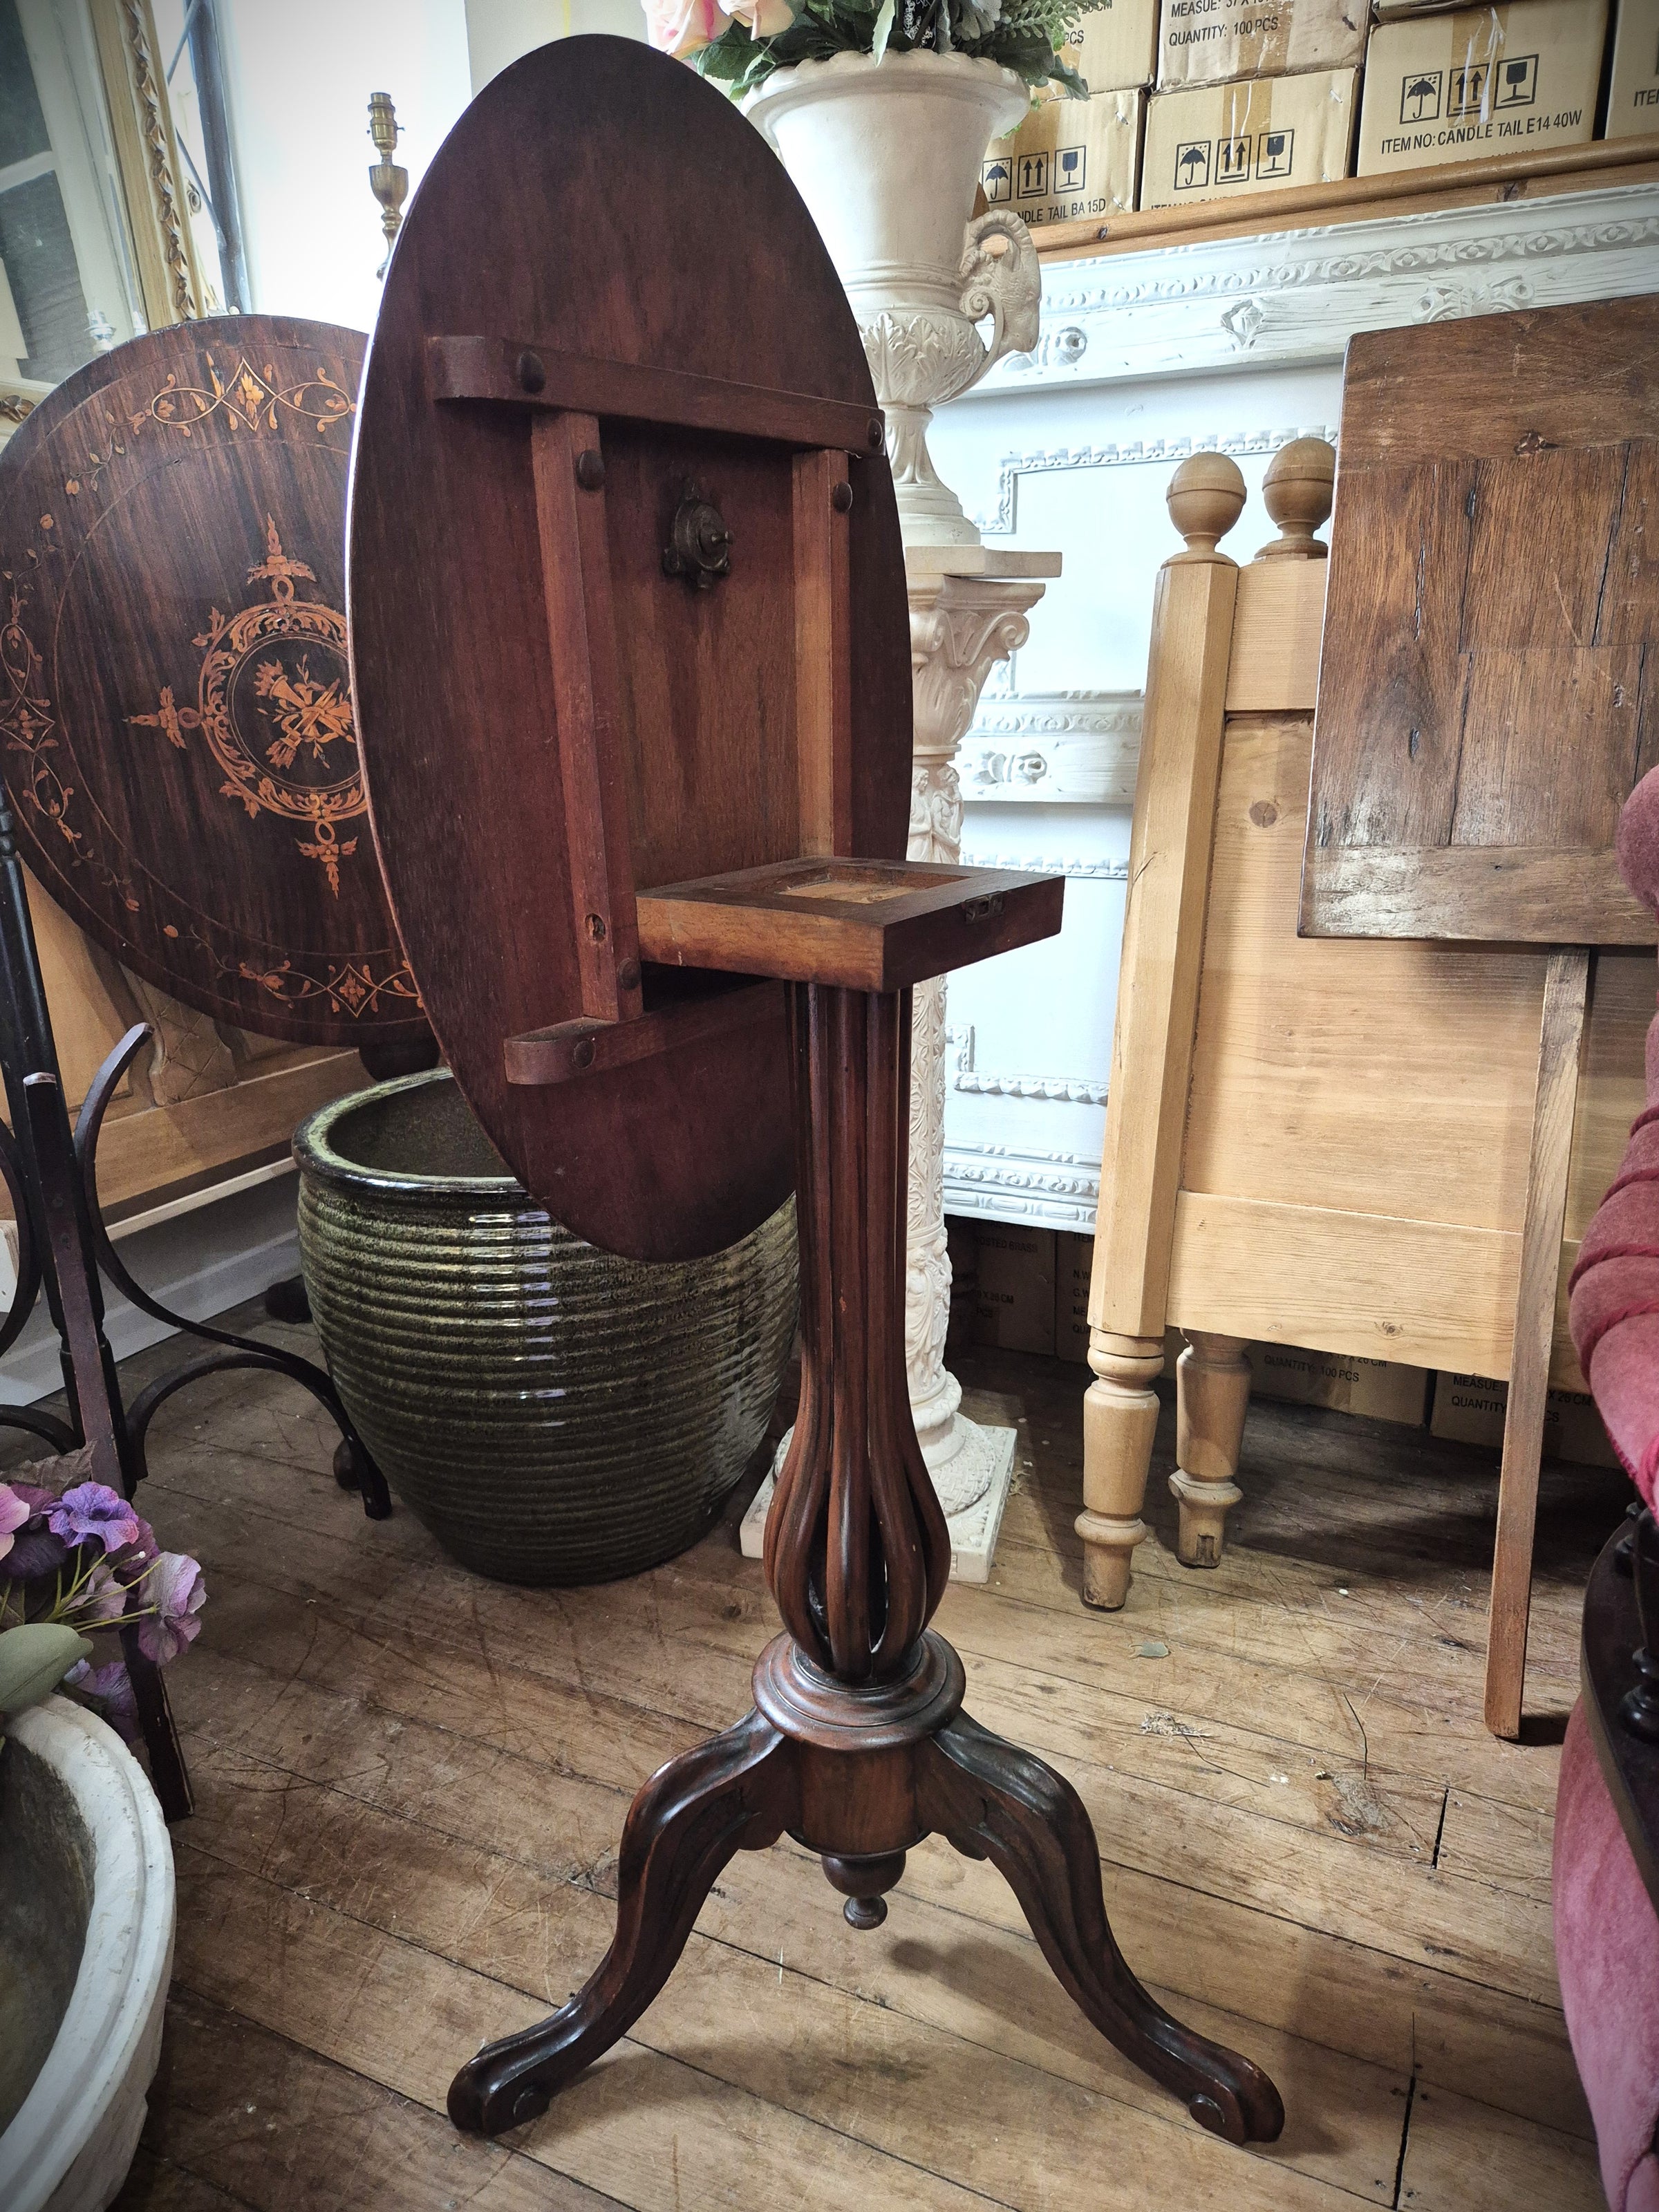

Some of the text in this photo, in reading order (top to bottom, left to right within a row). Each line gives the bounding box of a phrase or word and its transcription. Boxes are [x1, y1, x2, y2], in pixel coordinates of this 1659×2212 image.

[1169, 17, 1279, 46] QUANTITY: 100 PCS
[1381, 109, 1583, 155] ITEM NO: CANDLE TAIL E14 40W
[1048, 205, 1069, 221] TAIL
[1338, 1369, 1360, 1382] PCS
[1454, 1376, 1503, 1392] MEASUE:
